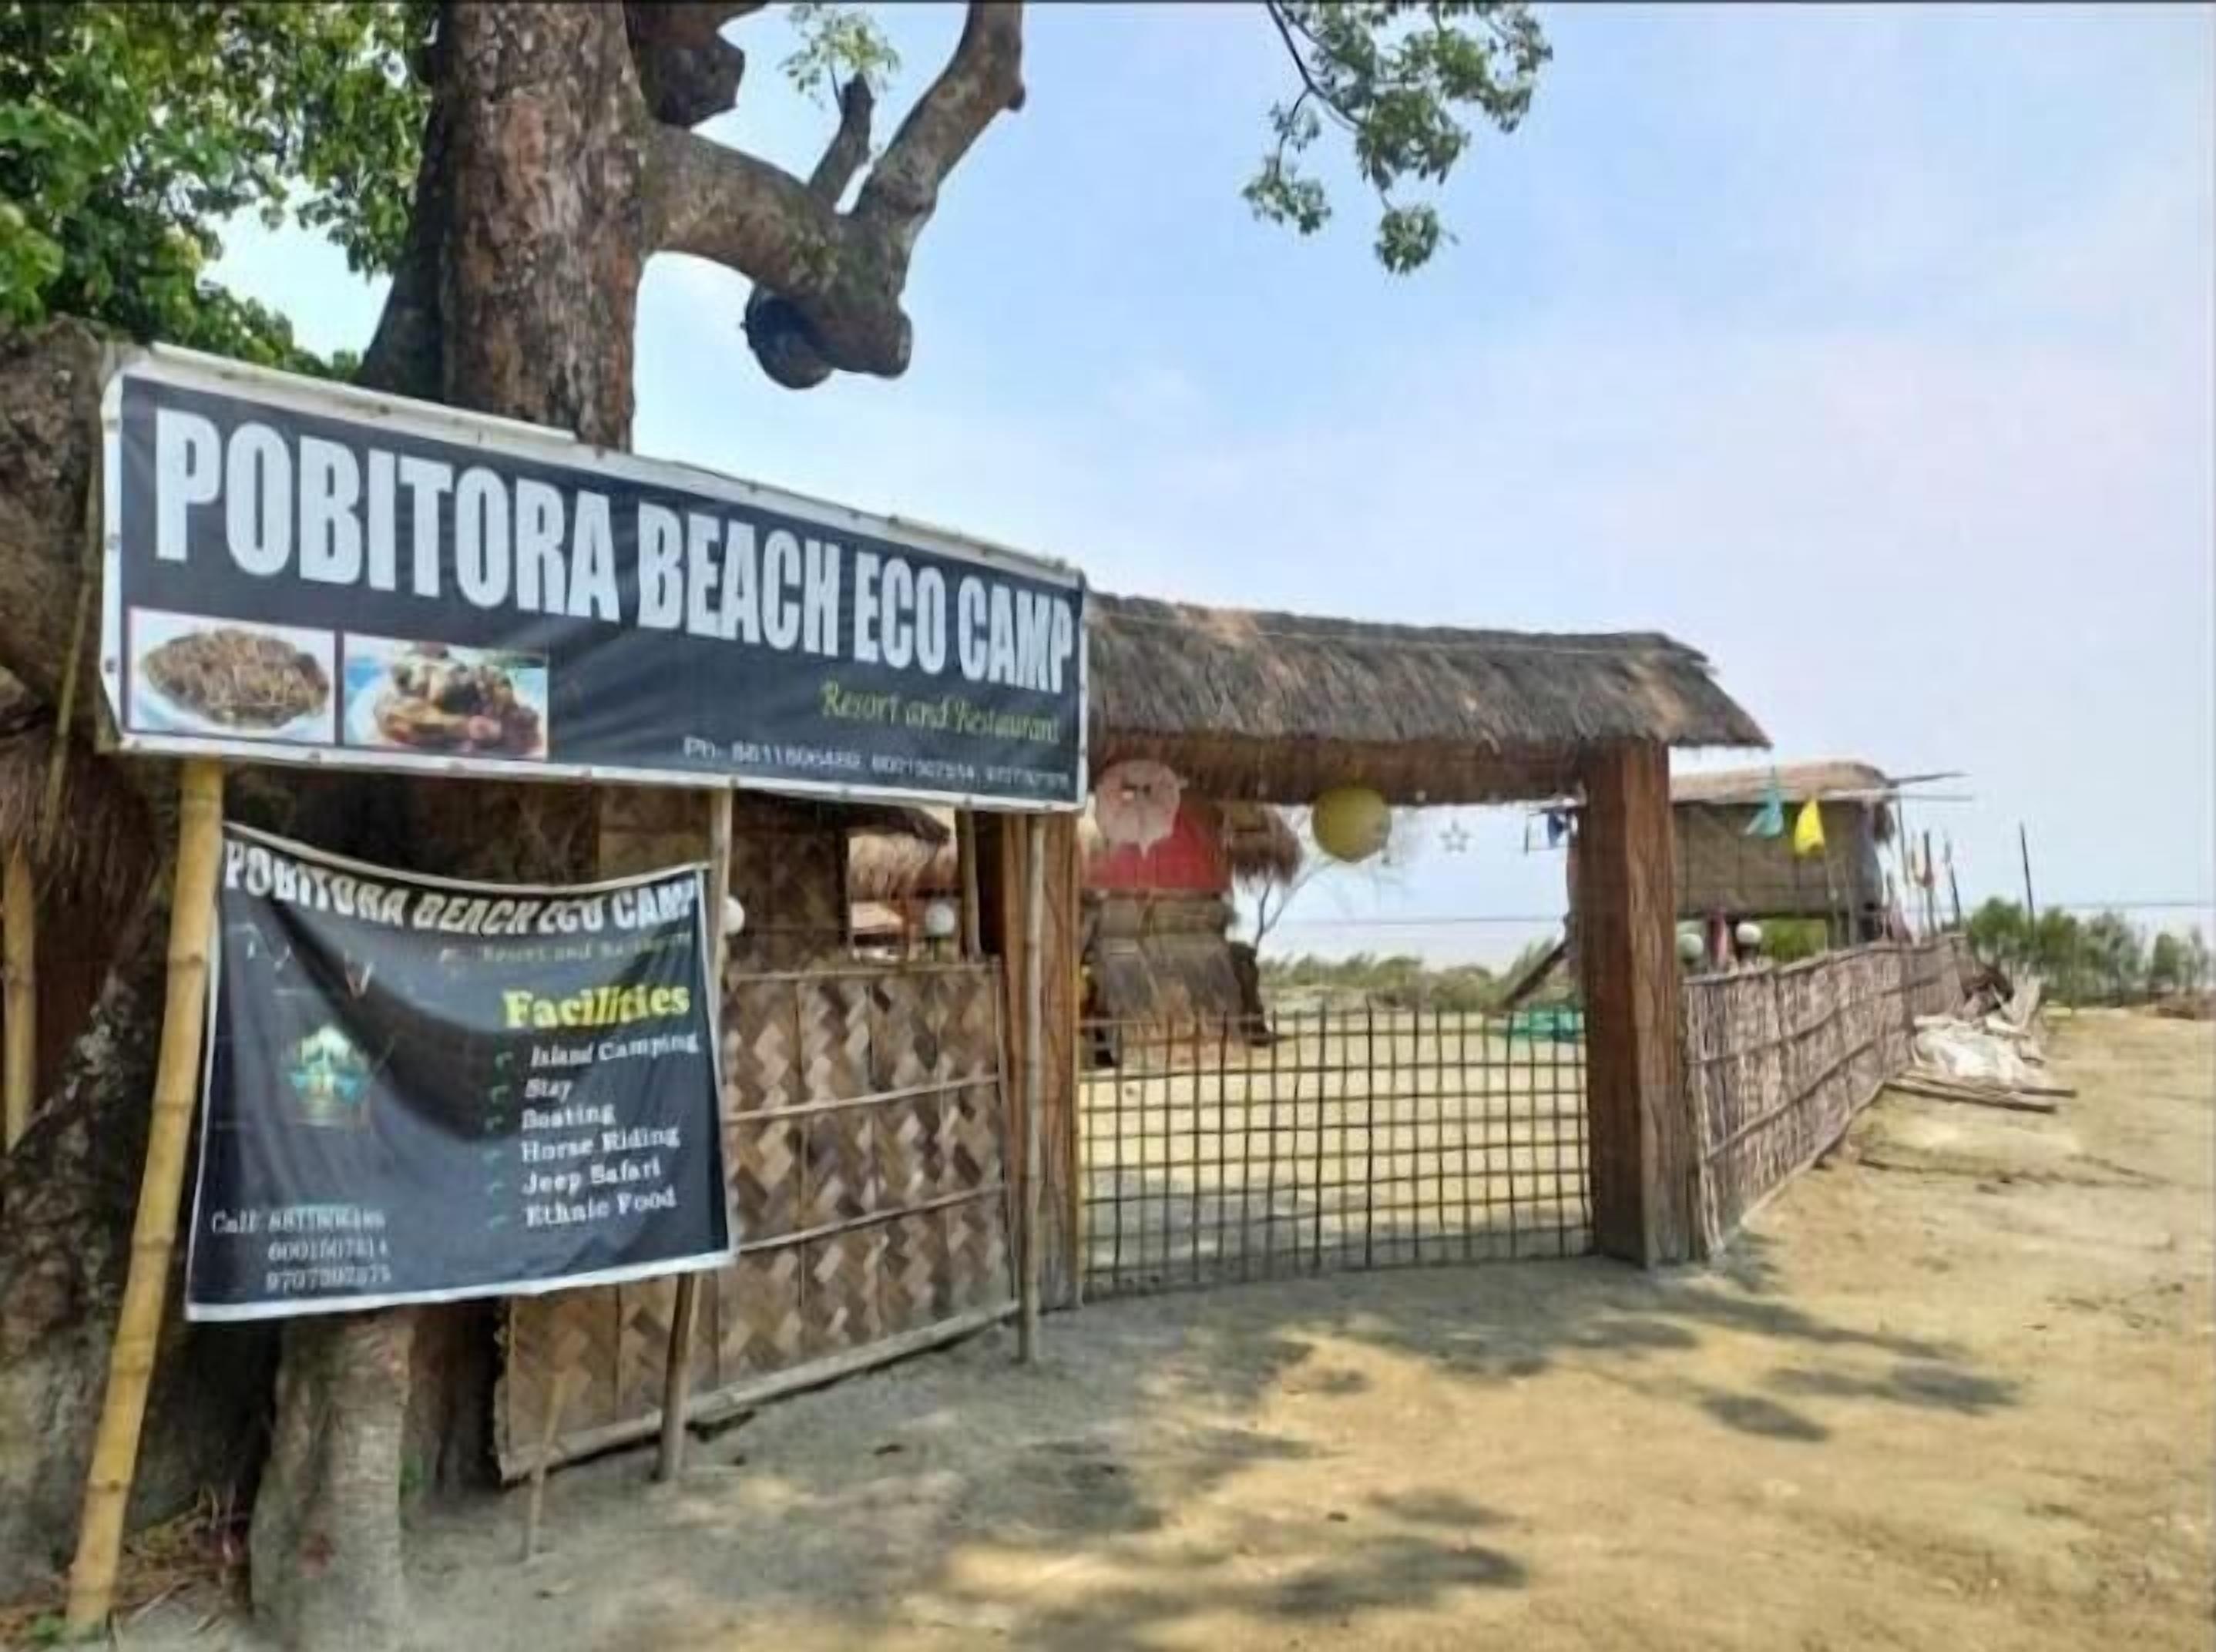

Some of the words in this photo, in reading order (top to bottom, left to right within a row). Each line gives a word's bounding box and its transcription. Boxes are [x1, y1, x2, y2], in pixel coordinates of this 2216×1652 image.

[156, 407, 621, 622] POBITORA
[636, 502, 841, 657] BEACH
[854, 550, 947, 675] ECO
[958, 576, 1073, 693] CAMP
[224, 841, 410, 929] POBITORA
[412, 891, 542, 936] BEACH
[537, 894, 607, 935] ECO
[613, 878, 698, 931] CAMP
[503, 984, 693, 1029] Facilities
[598, 1033, 700, 1060] Camping
[522, 1103, 616, 1130] Boating
[521, 1139, 595, 1163] Horse
[601, 1127, 681, 1154] Riding
[522, 1171, 583, 1197] Jeep
[590, 1157, 662, 1185] Safari
